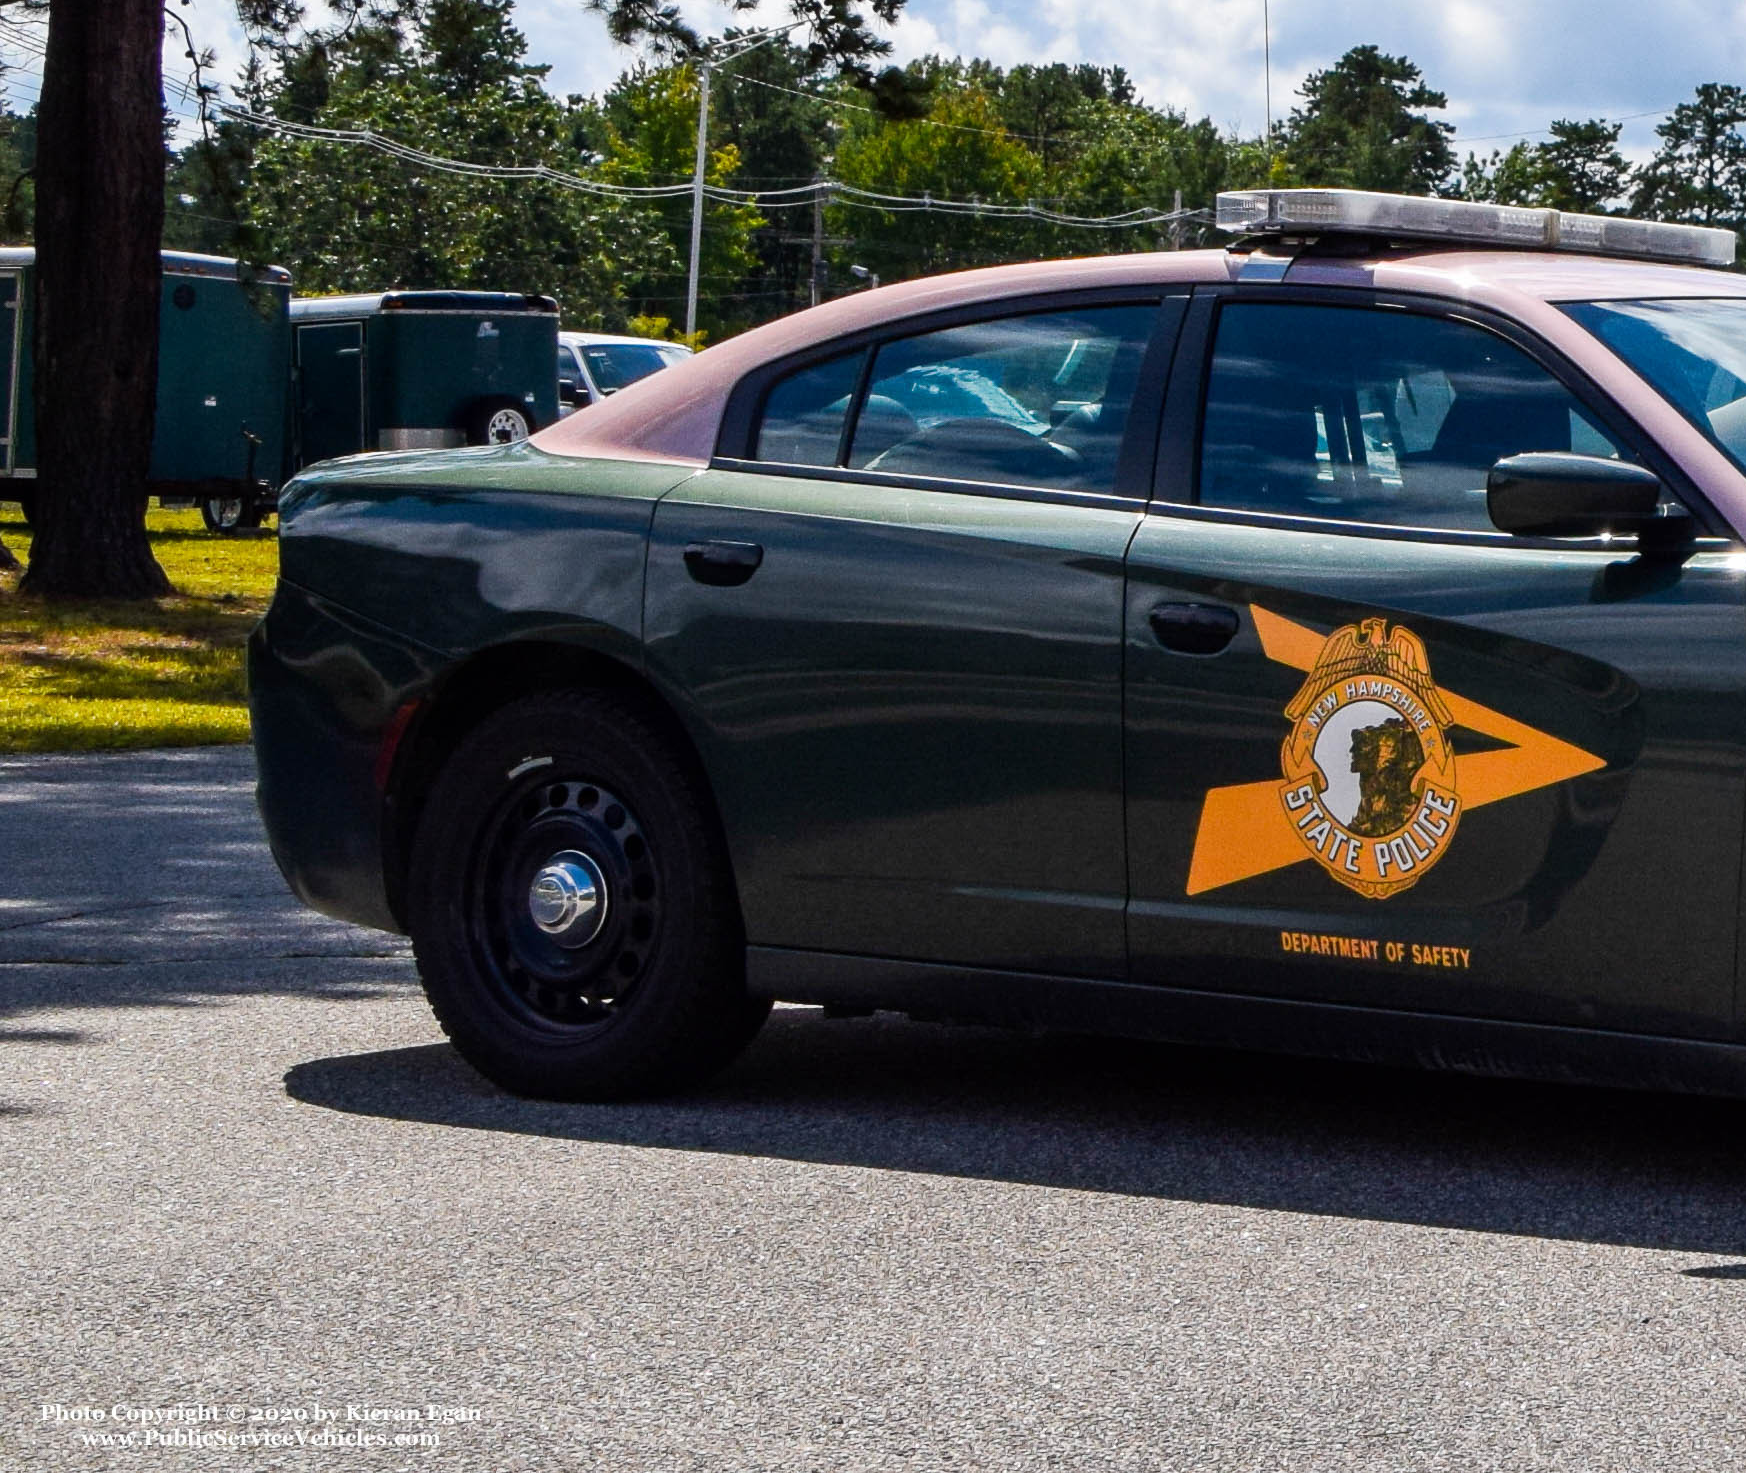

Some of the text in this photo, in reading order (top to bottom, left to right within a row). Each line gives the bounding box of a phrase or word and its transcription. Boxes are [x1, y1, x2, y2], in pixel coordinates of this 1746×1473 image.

[1307, 681, 1432, 732] NEW HAMPSHIRE
[1285, 784, 1456, 877] STATE POLICE
[1281, 932, 1471, 968] DEPARTMENT OF SAFETY
